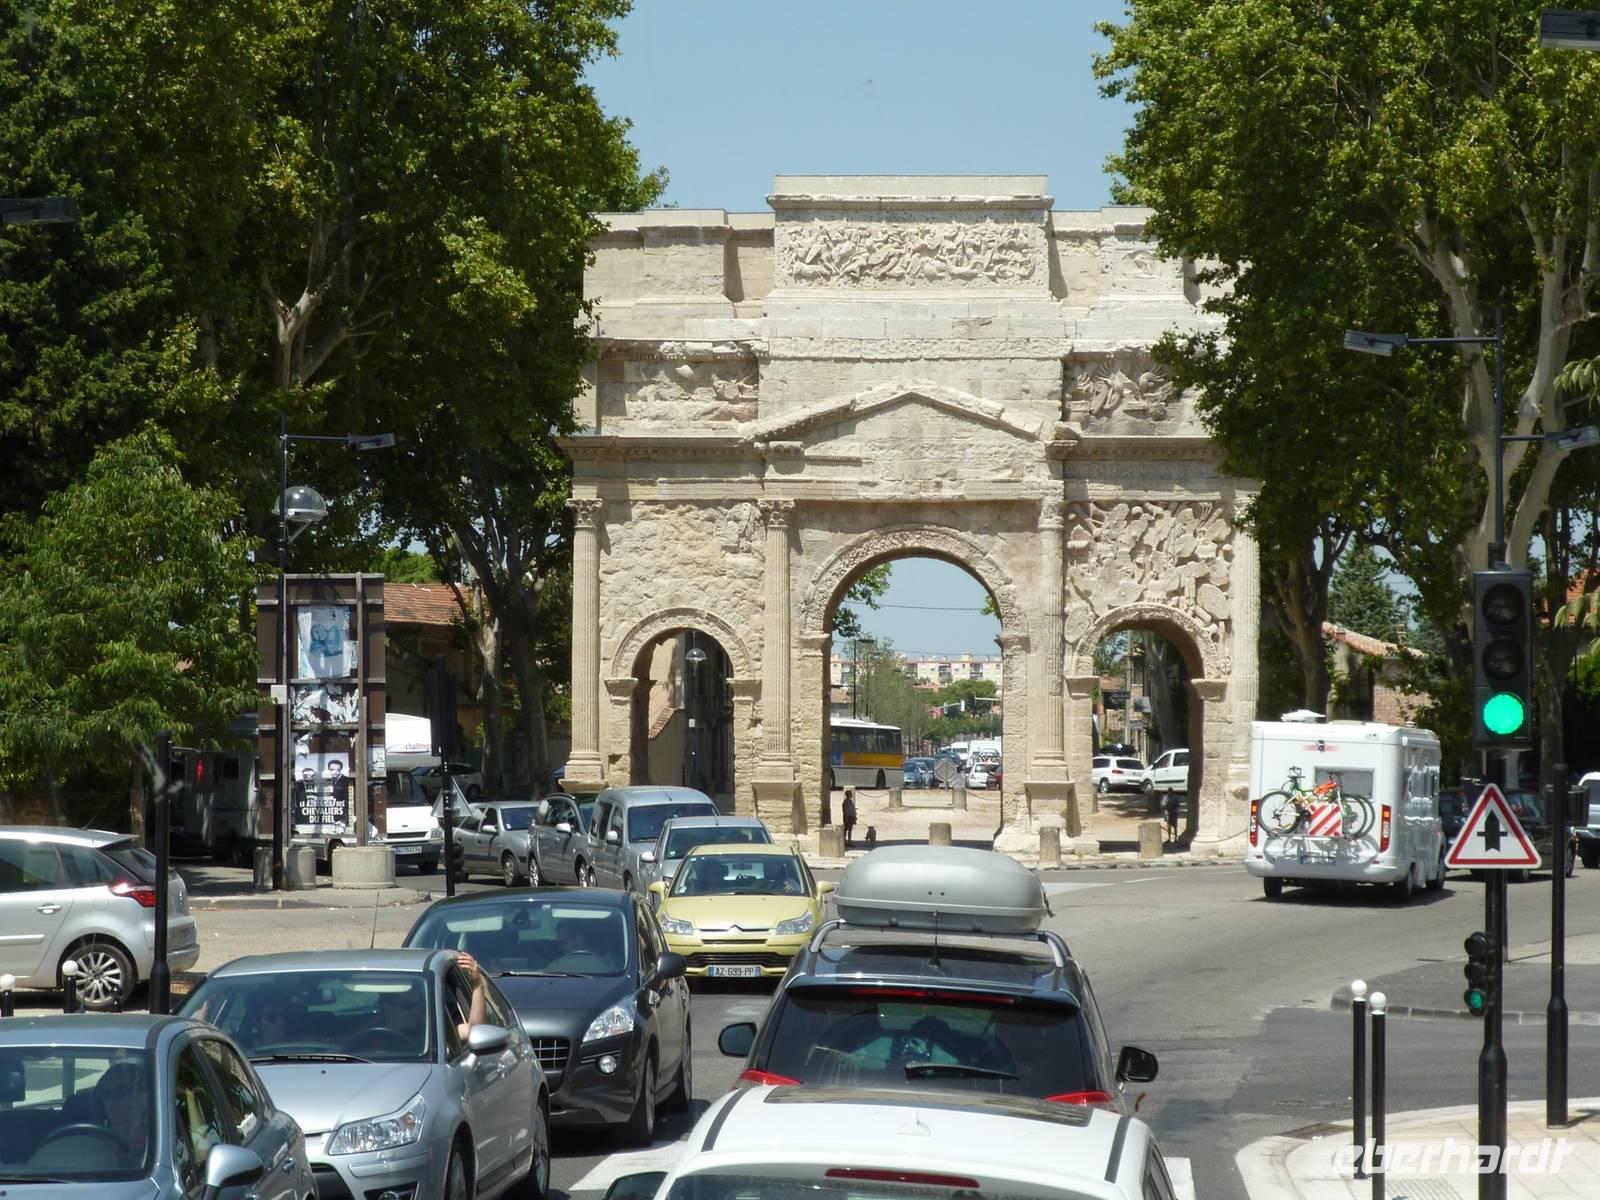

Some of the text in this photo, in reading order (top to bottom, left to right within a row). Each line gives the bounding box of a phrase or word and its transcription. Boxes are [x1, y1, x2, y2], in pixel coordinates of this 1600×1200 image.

[302, 807, 343, 815] CHEVALIERS
[310, 815, 335, 823] DU FIEL
